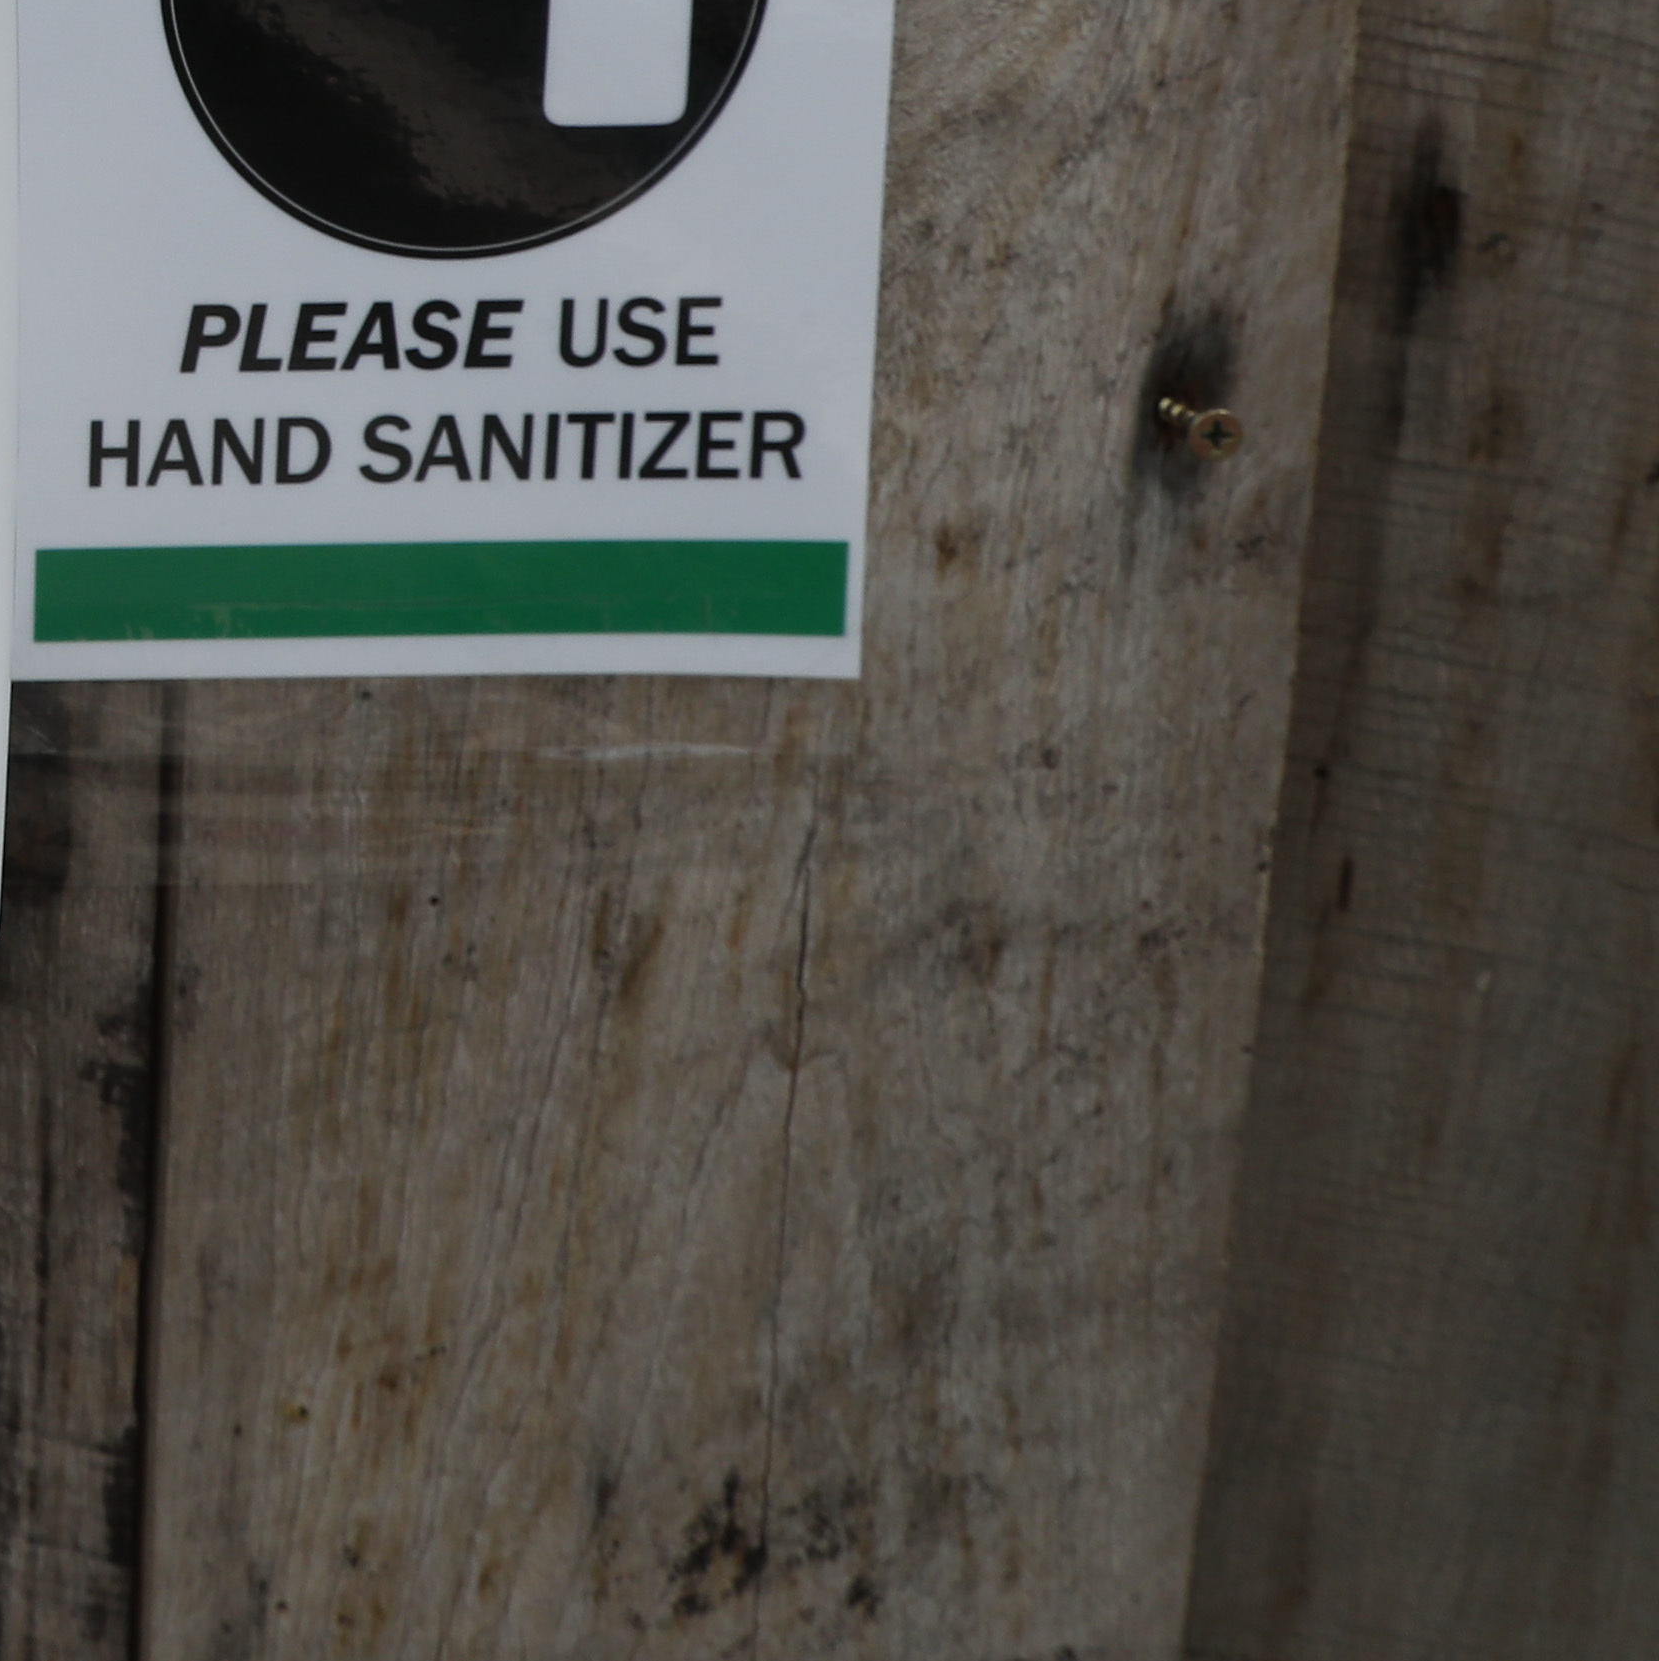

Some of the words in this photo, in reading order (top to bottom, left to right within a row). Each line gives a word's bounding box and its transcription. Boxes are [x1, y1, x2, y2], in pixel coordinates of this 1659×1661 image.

[179, 299, 525, 374] PLEASE
[558, 296, 723, 369] USE
[88, 416, 332, 488] HAND
[359, 410, 806, 484] SANITIZER
